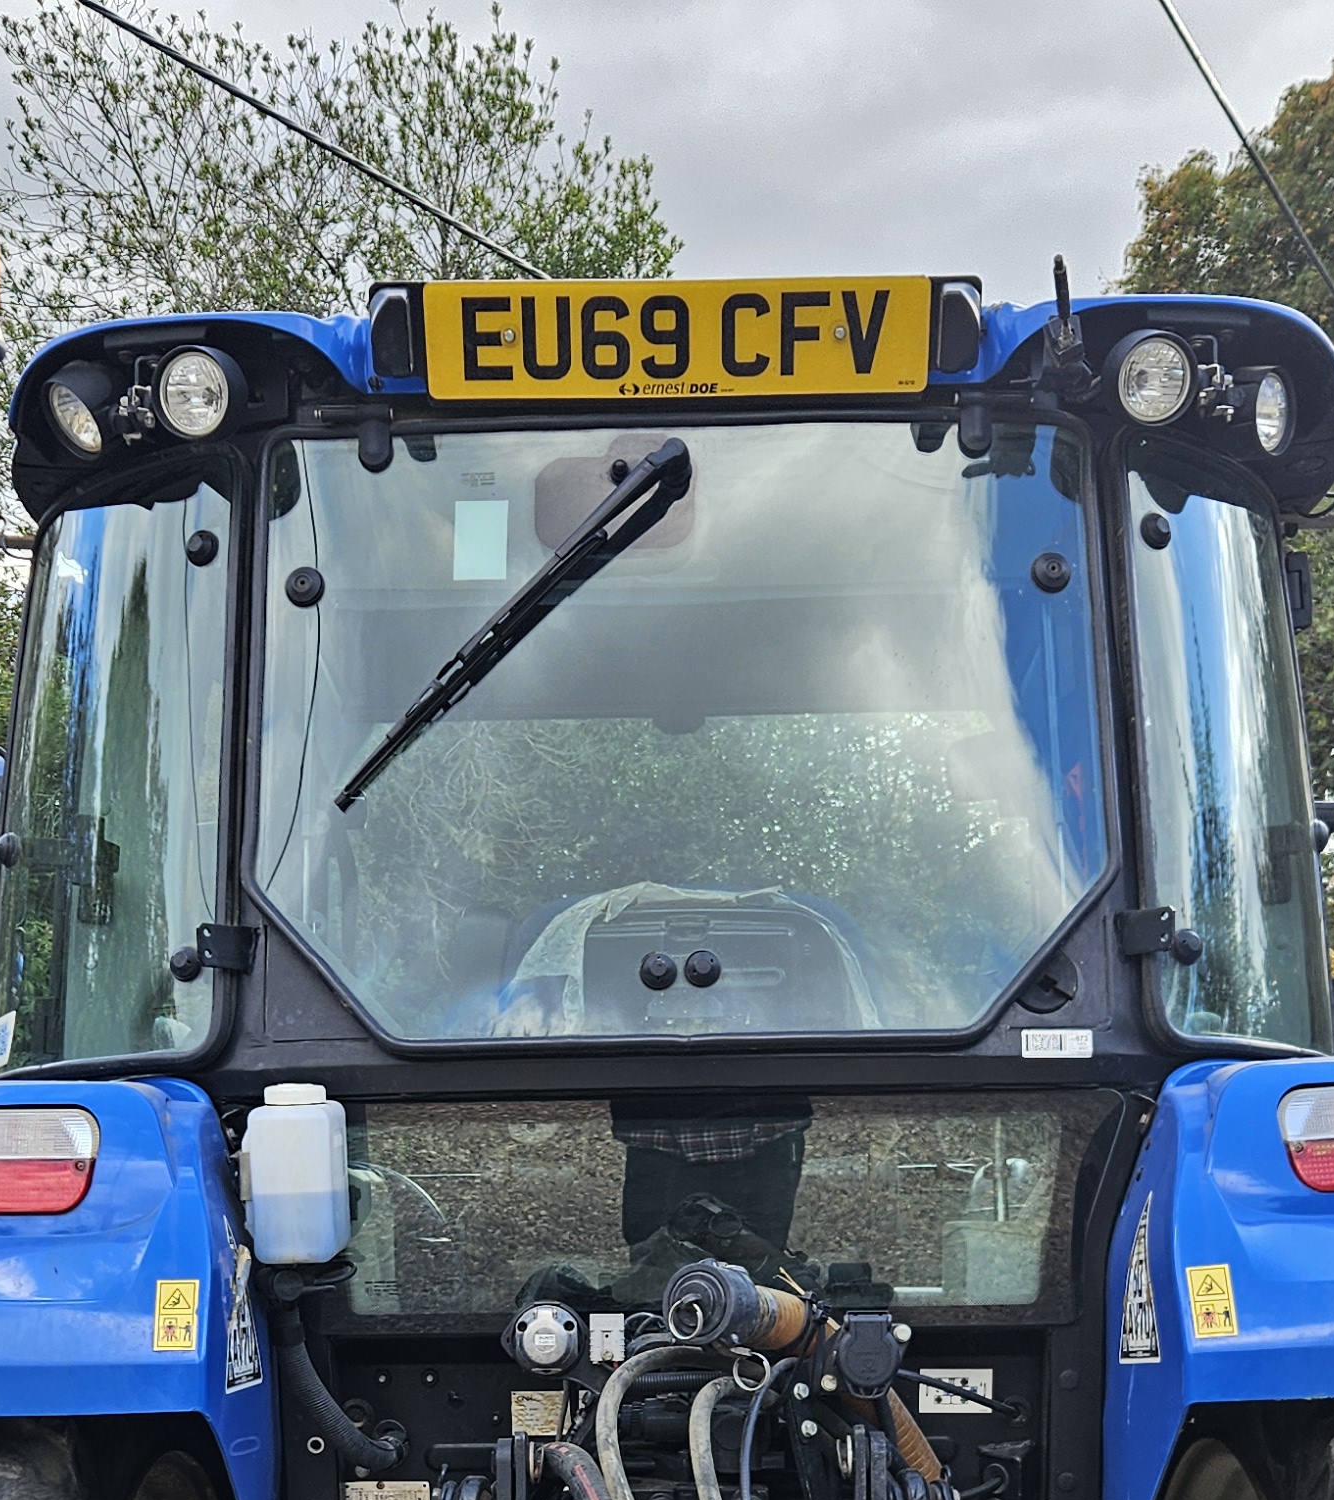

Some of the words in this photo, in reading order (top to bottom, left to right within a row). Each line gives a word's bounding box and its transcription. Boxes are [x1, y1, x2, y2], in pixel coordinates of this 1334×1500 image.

[462, 295, 690, 380] EU69
[721, 290, 890, 377] CFV
[643, 382, 685, 394] ernest
[689, 383, 718, 394] DOE
